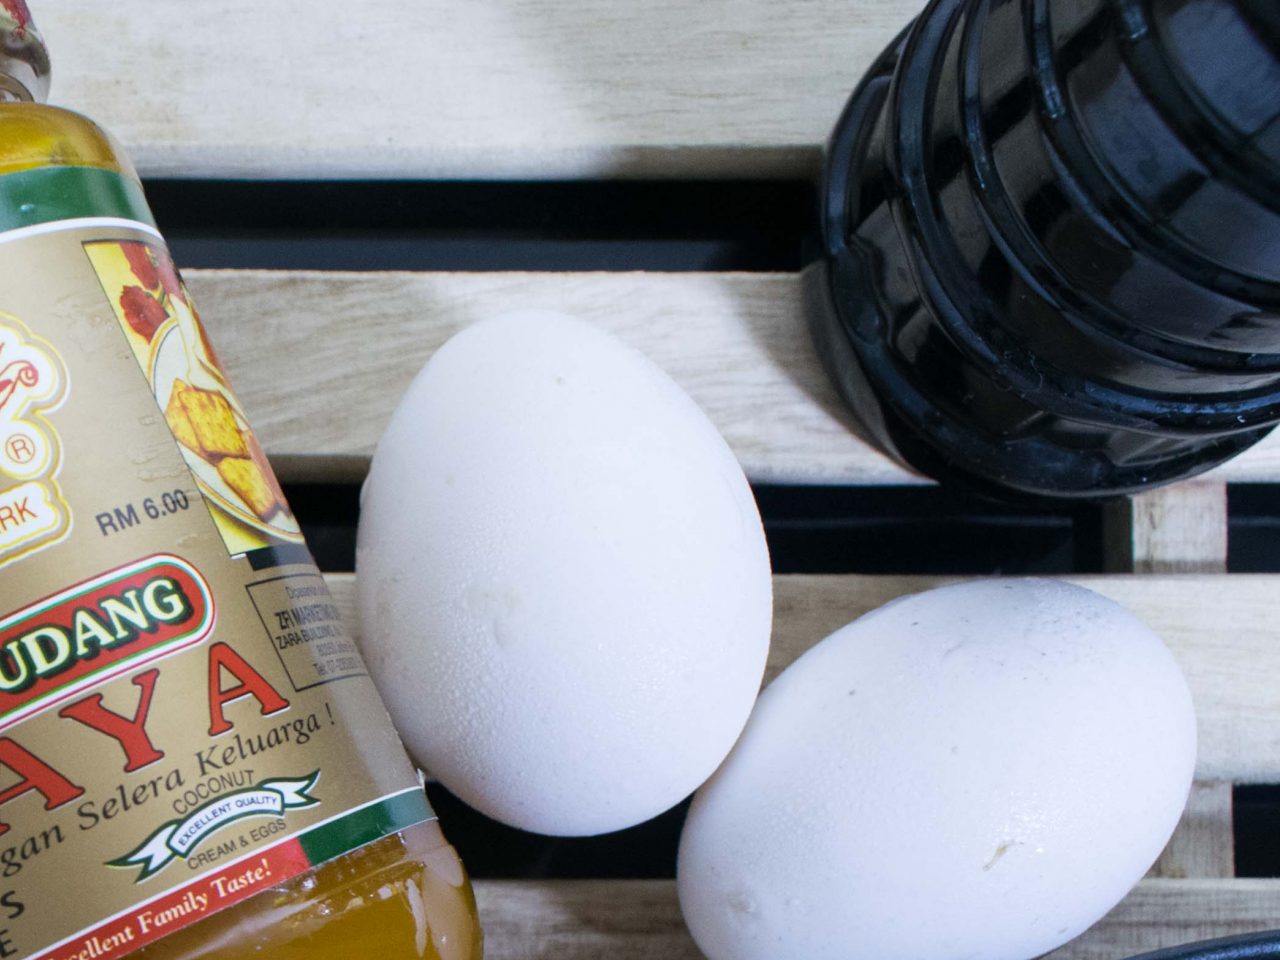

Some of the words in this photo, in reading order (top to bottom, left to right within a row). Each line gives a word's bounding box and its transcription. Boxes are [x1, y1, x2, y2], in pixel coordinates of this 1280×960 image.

[95, 506, 141, 537] RM
[145, 489, 190, 521] 6.00
[76, 768, 186, 831] Selera
[195, 712, 322, 778] Keluarga
[172, 769, 255, 815] COCONUT
[177, 803, 232, 847] EXCELLENT
[235, 796, 278, 809] QUALITY
[187, 841, 237, 870] CREAM
[238, 834, 249, 848] &
[249, 818, 288, 843] EGGS
[137, 892, 209, 934] Family
[210, 857, 272, 898] Taste!
